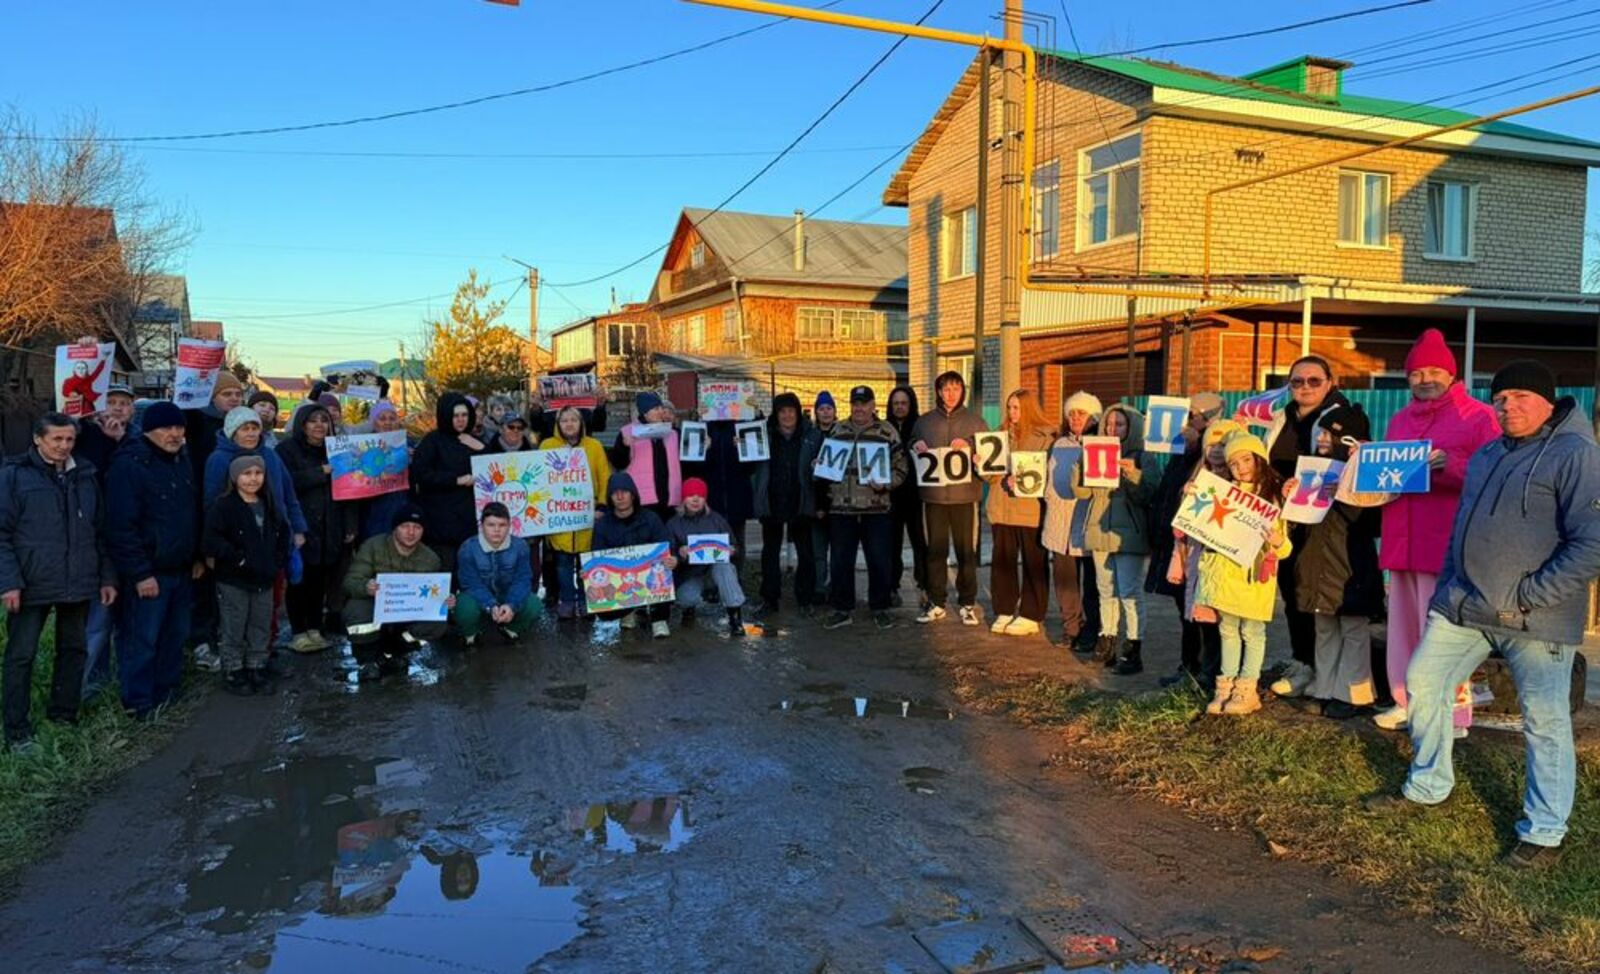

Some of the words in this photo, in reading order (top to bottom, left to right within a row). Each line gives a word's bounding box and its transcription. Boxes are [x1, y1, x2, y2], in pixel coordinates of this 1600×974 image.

[1148, 405, 1188, 444] П
[683, 427, 706, 456] П
[739, 427, 764, 457] П
[980, 435, 1006, 472] 2
[1361, 445, 1424, 464] ППМИ
[819, 444, 849, 471] М
[859, 446, 887, 478] И
[1084, 443, 1119, 479] П
[547, 469, 587, 485] ВМЕСТЕ
[546, 499, 590, 514] СМОЖЕМ
[1226, 485, 1279, 522] ППМИ
[548, 514, 589, 529] БОЛЬШЕ
